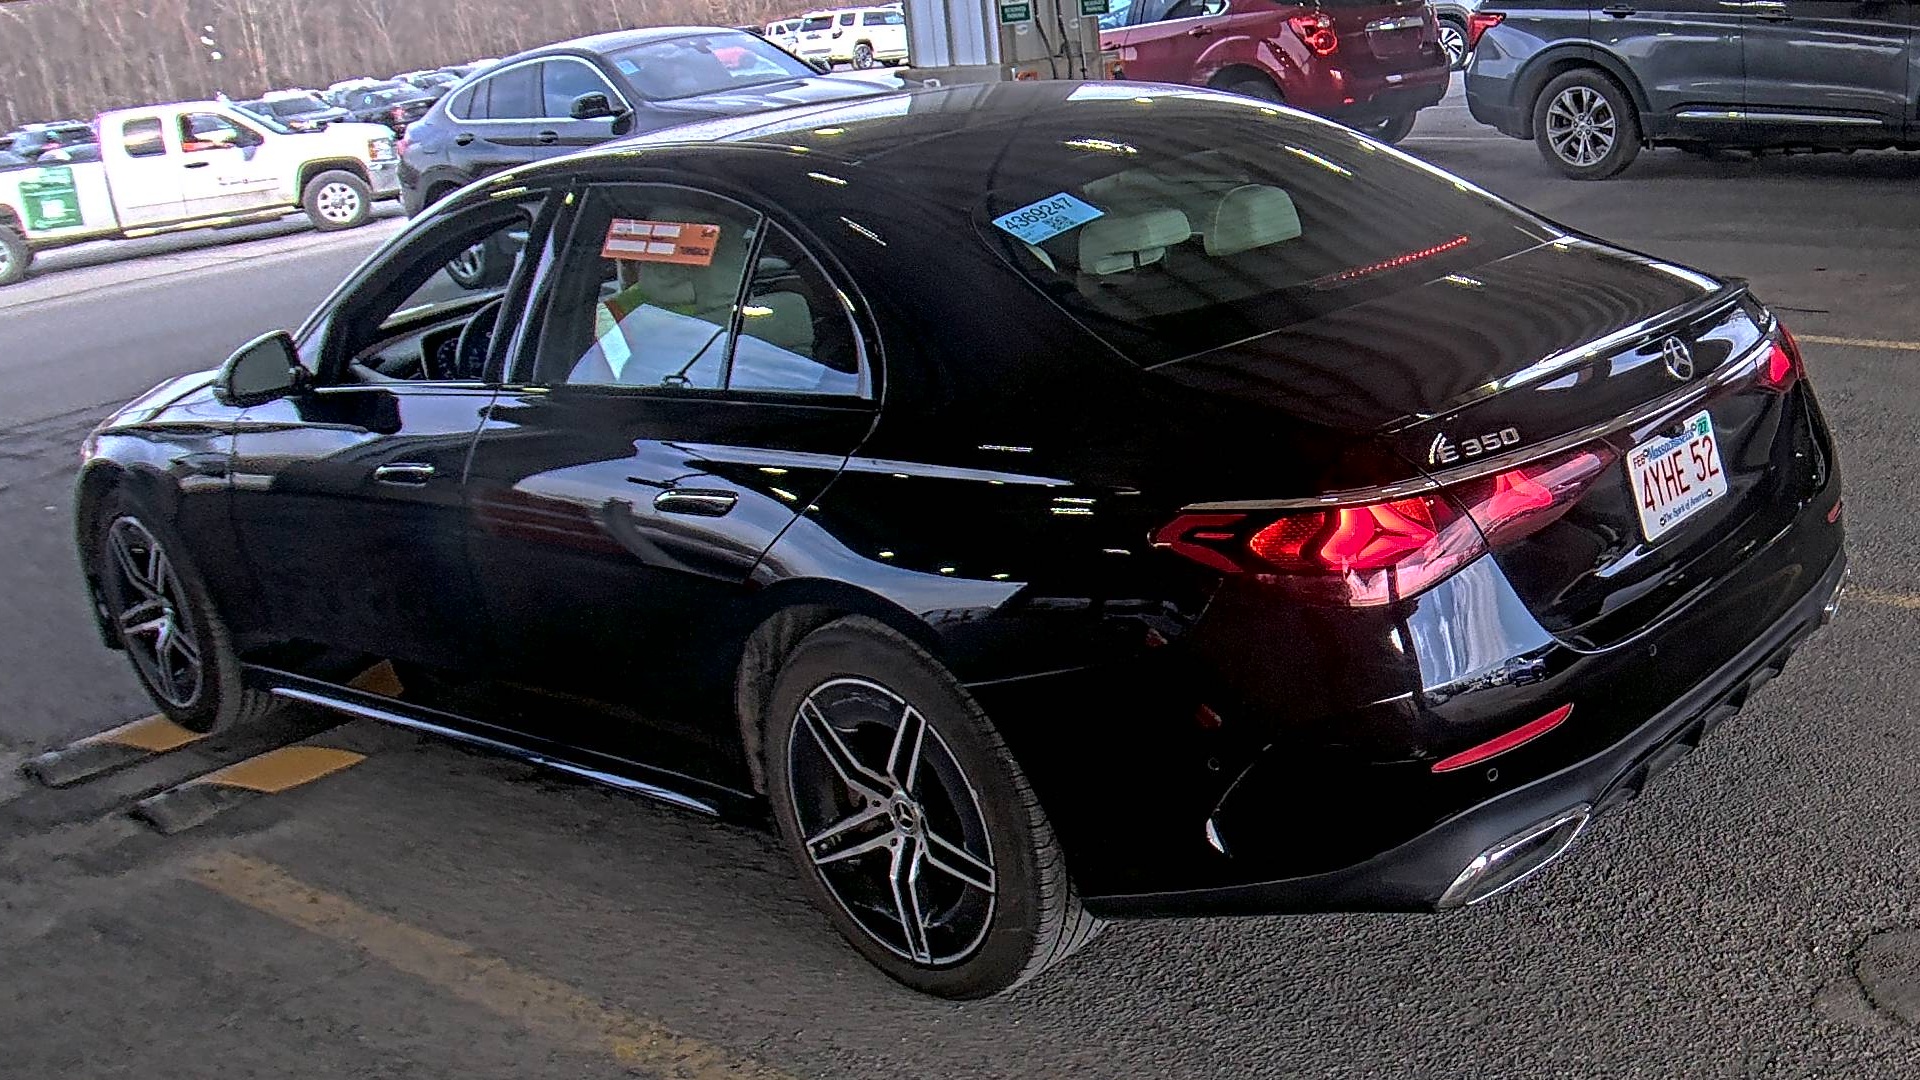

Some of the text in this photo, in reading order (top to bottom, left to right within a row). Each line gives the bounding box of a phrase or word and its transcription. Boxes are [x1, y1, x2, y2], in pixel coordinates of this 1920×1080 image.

[1004, 197, 1072, 230] 4369247
[1461, 427, 1520, 457] 350
[1643, 435, 1720, 512] 4YHE 52
